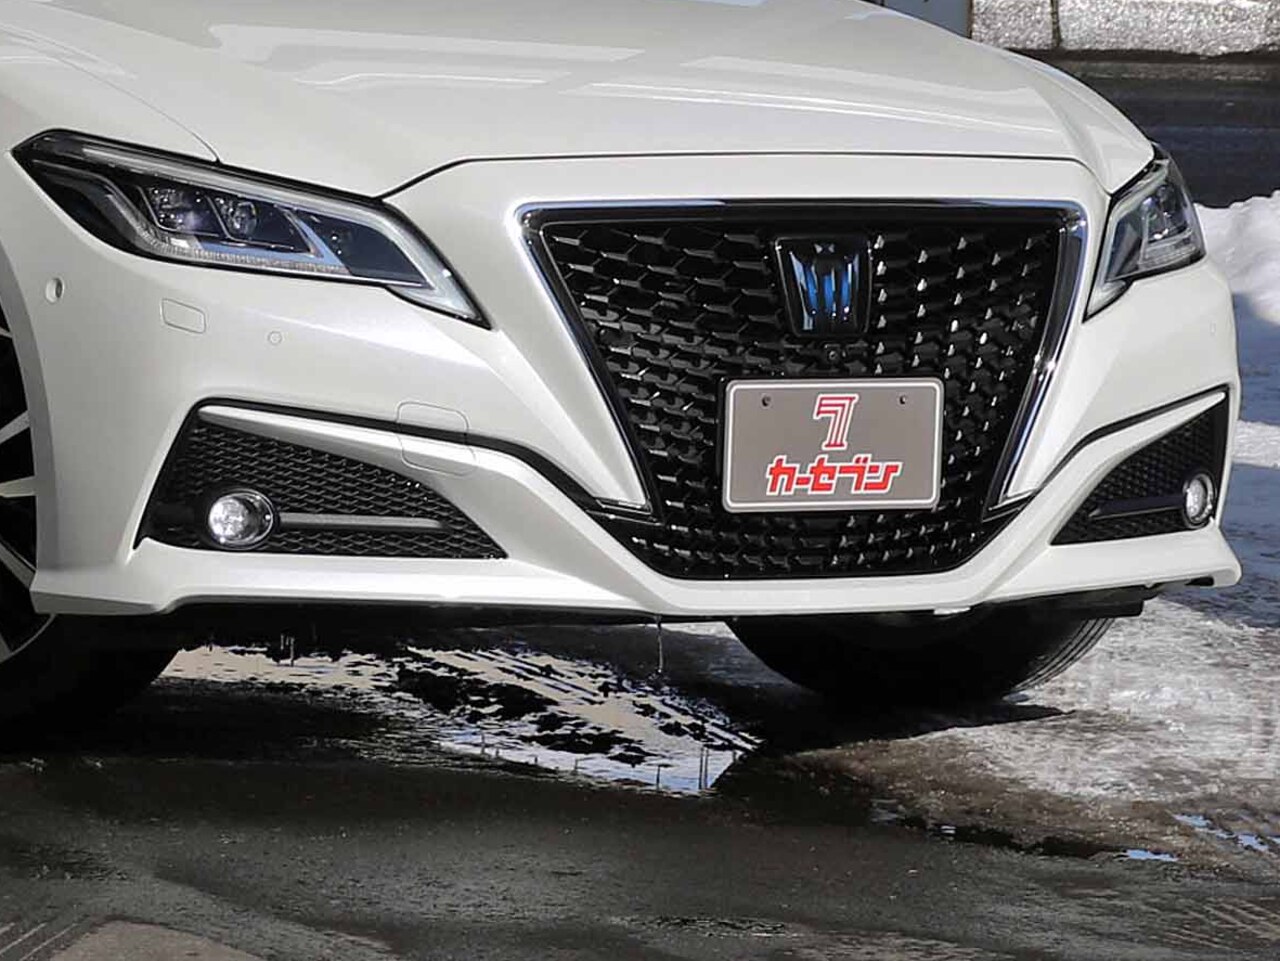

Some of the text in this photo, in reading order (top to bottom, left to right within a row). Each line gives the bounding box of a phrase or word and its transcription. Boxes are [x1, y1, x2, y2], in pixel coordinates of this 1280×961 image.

[766, 453, 903, 496] カーセブン
